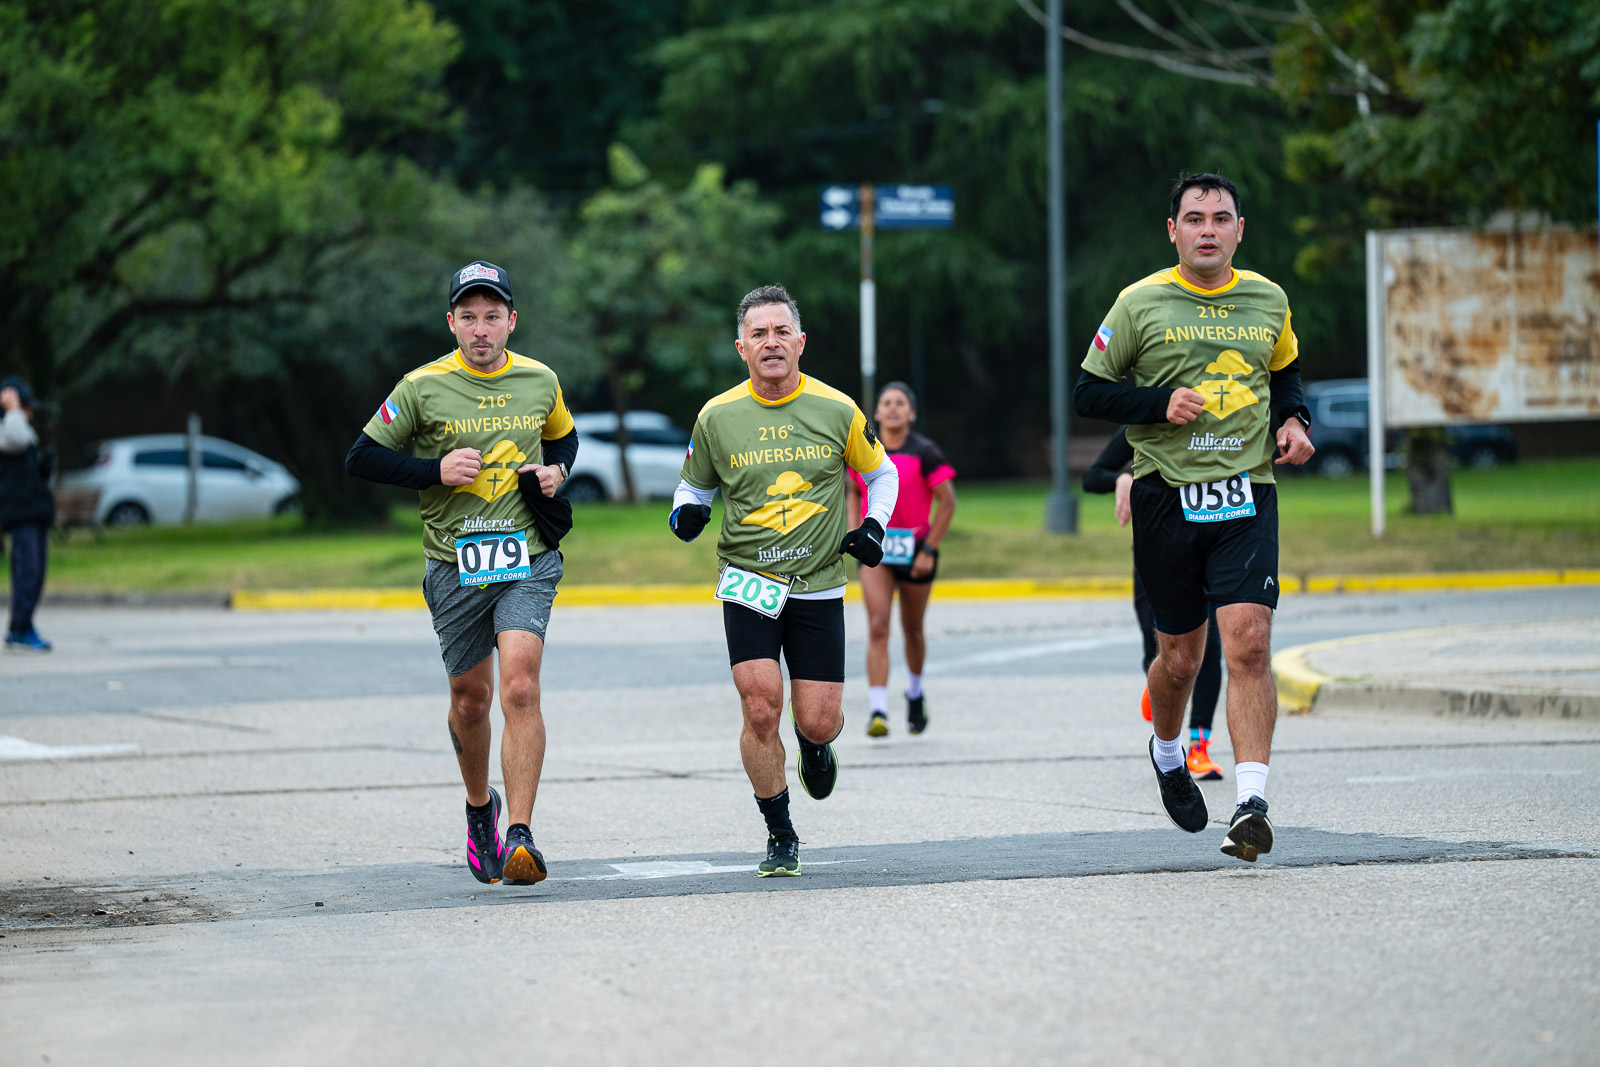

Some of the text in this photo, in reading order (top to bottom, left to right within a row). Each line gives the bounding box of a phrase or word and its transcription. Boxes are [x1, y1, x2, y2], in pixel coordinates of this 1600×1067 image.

[1196, 304, 1235, 319] 216°
[1165, 325, 1272, 345] ANIVERSARIO
[477, 393, 512, 409] 216°
[444, 415, 543, 435] ANIVERSARIO
[758, 424, 794, 441] 216°
[1187, 432, 1245, 451] julicroc
[730, 444, 832, 469] ANIVERSARIO
[1184, 474, 1246, 512] 058
[1188, 508, 1251, 520] DIAMANTE CORRE
[460, 515, 516, 532] julicroc
[461, 536, 522, 575] 079
[757, 544, 813, 562] julicroc
[464, 571, 528, 585] DIAMANTE CORRE
[721, 571, 781, 610] 203
